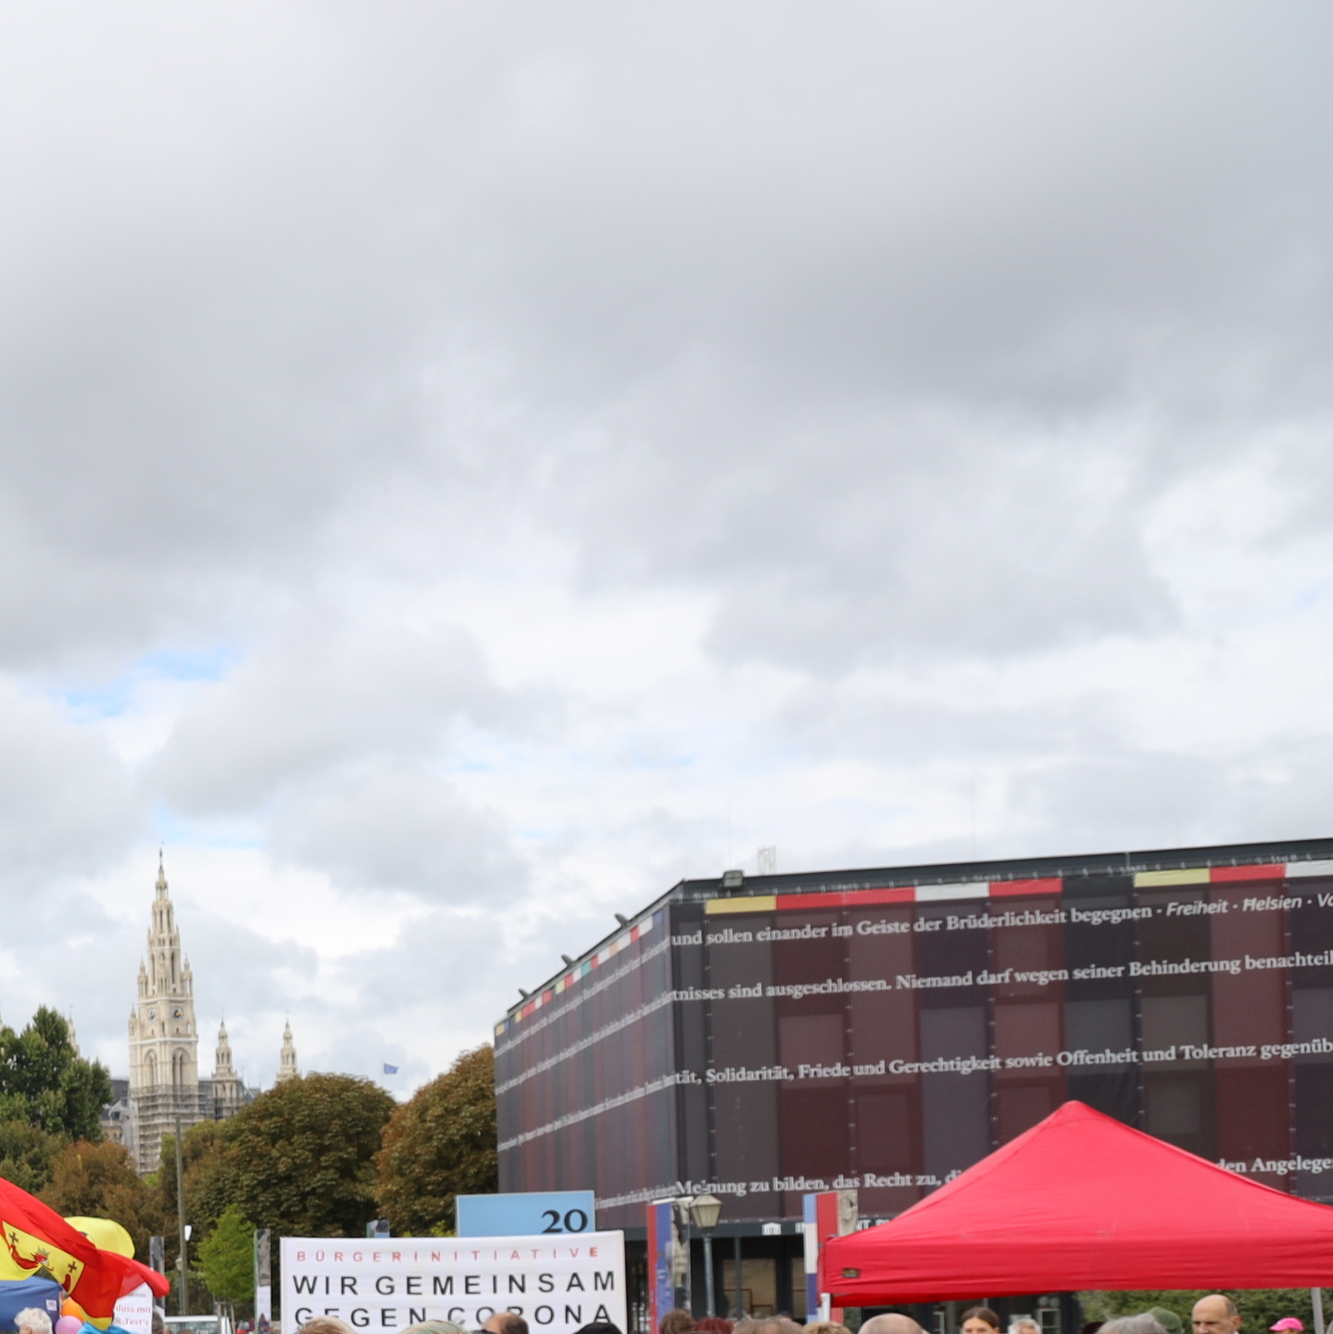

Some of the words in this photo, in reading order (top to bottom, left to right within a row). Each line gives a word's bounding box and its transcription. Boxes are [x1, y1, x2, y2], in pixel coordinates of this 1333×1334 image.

[671, 929, 704, 946] und
[706, 928, 754, 945] sollen
[755, 923, 826, 942] einander
[832, 922, 854, 938] im
[856, 919, 910, 936] Geiste
[912, 916, 943, 933] der
[945, 908, 1068, 931] Brüderlichkeit
[1070, 906, 1152, 926] begegnen
[1166, 899, 1228, 917] Freiheit
[727, 982, 762, 999] sind
[765, 977, 892, 1000] ausgeschlossen.
[894, 970, 973, 990] Niemand
[976, 968, 1011, 986] darf
[1014, 969, 1069, 986] wegen
[1072, 963, 1126, 980] seiner
[1128, 957, 1241, 977] Behinderung
[706, 1065, 794, 1083] Solidarität,
[798, 1061, 851, 1079] Friede
[852, 1059, 885, 1076] und
[888, 1054, 1001, 1076] Gerechtigkeit
[1004, 1051, 1054, 1069] sowie
[1056, 1047, 1138, 1066] Offenheit
[1142, 1045, 1176, 1062] und
[1179, 1043, 1257, 1060] Toleranz
[1250, 1152, 1333, 1176] Angelege
[750, 1179, 770, 1193] zu
[772, 1175, 830, 1193] bilden,
[832, 1172, 861, 1190] das
[863, 1171, 912, 1188] Recht
[915, 1174, 942, 1189] zu,
[541, 1208, 589, 1234] 20
[296, 1246, 600, 1263] BÜRGERINITIATIVE
[292, 1275, 358, 1296] WIR
[374, 1270, 616, 1297] GEMEINSAM
